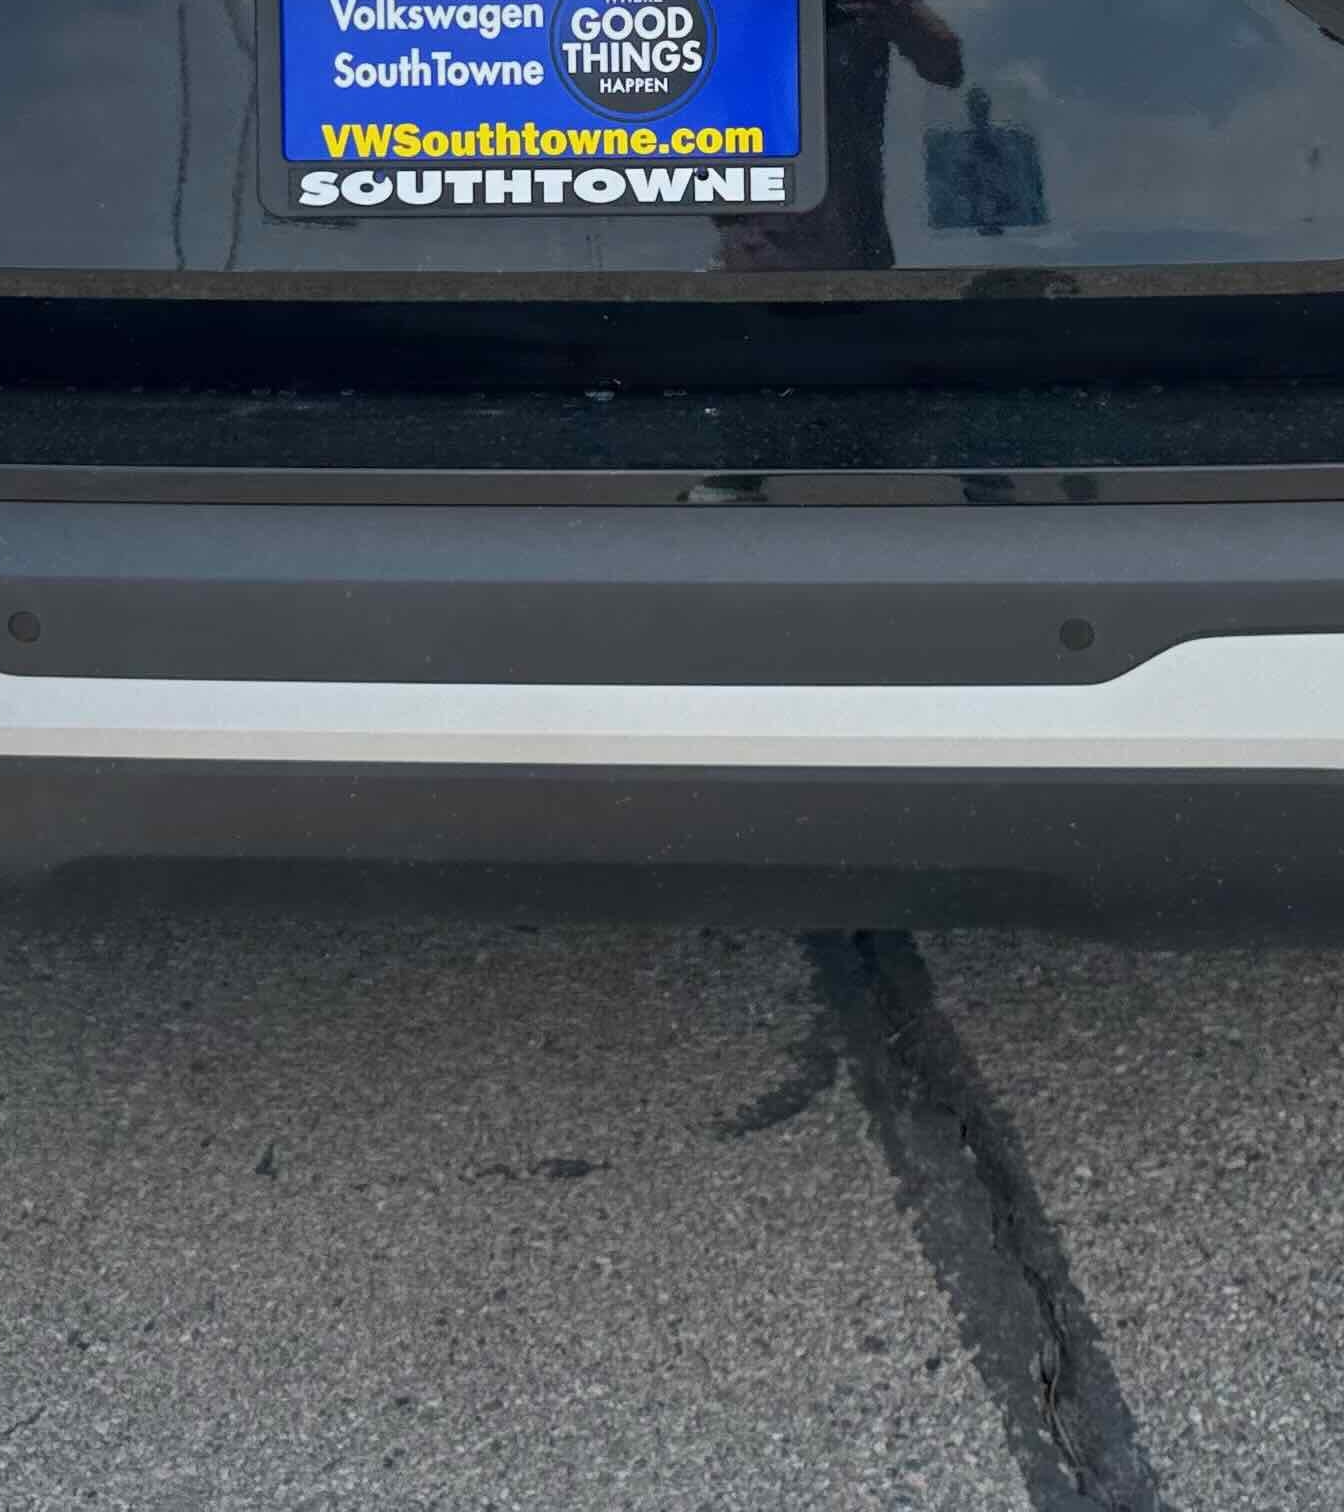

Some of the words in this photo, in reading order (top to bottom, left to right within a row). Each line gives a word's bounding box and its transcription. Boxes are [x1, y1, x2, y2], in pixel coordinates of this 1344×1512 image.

[570, 6, 694, 40] GOOD
[333, 48, 544, 89] SouthTowne
[562, 39, 703, 74] THINGS
[599, 77, 668, 94] HAPPEN
[321, 122, 763, 158] VWSouthtowne.com
[298, 166, 785, 207] SOUTHTOWNE
